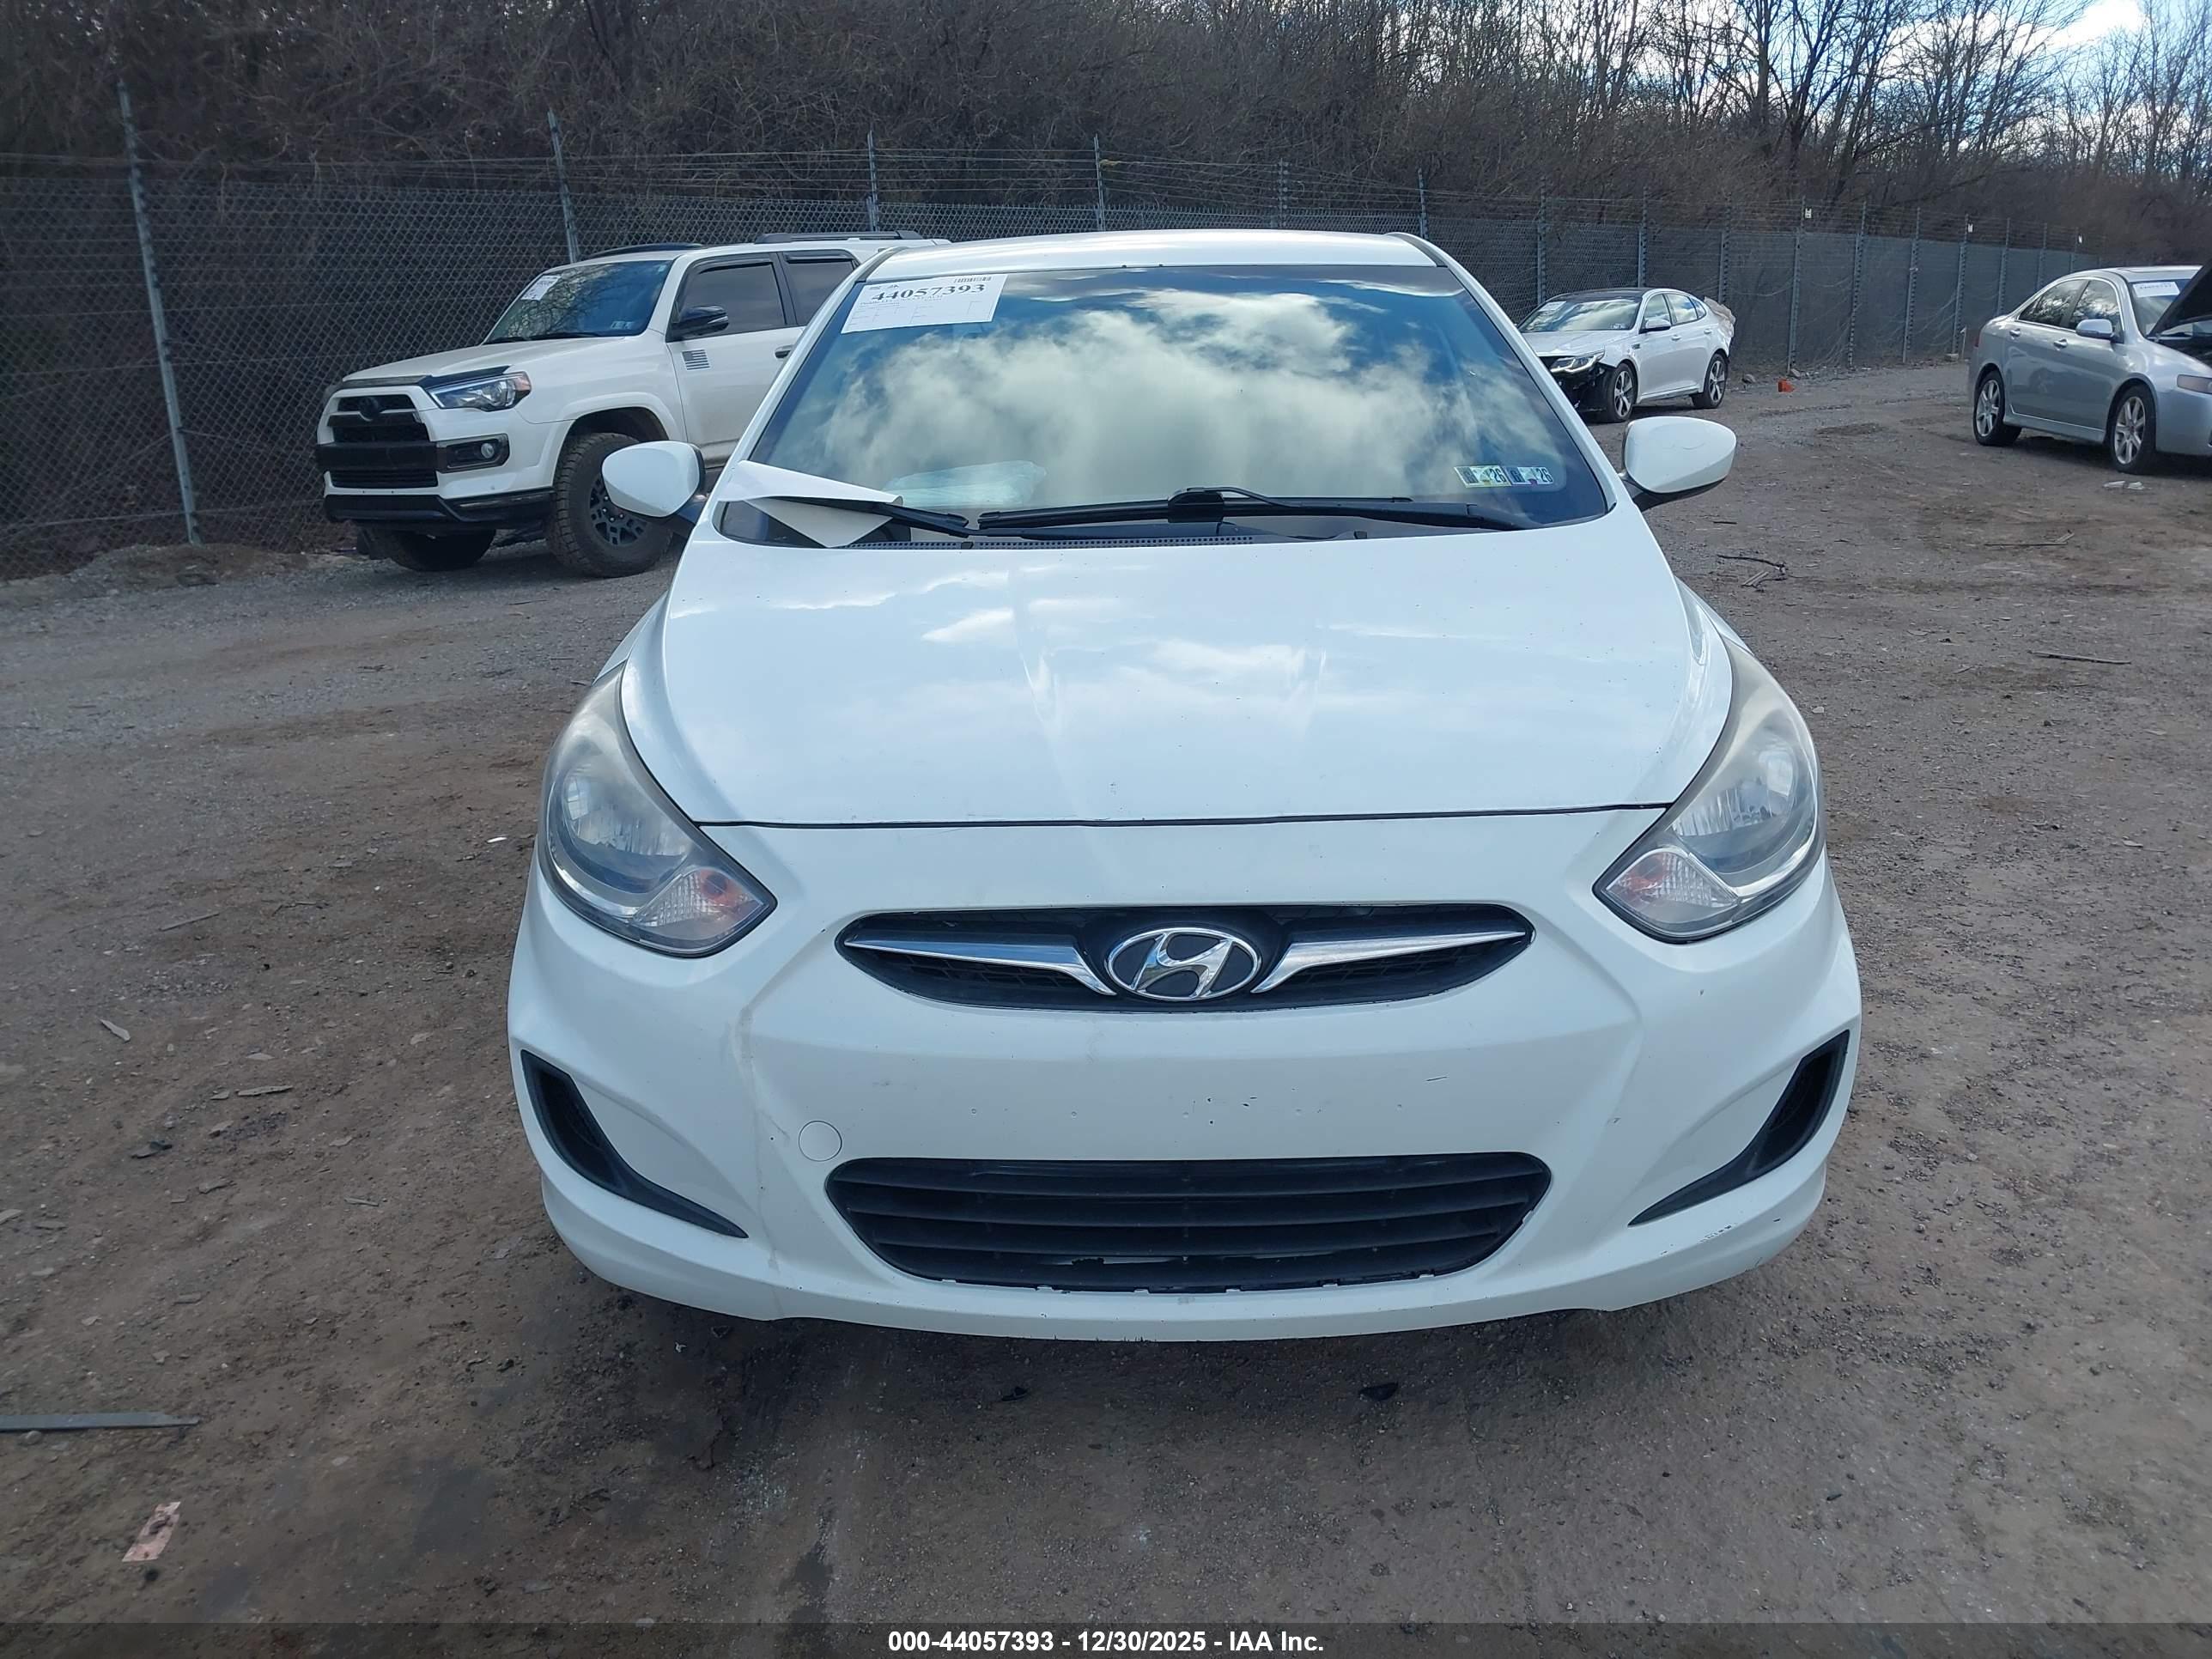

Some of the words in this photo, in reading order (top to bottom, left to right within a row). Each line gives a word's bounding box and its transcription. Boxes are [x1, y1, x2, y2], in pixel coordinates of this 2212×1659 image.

[872, 283, 986, 301] 44057393
[1489, 468, 1507, 483] 26
[1535, 468, 1553, 483] 26
